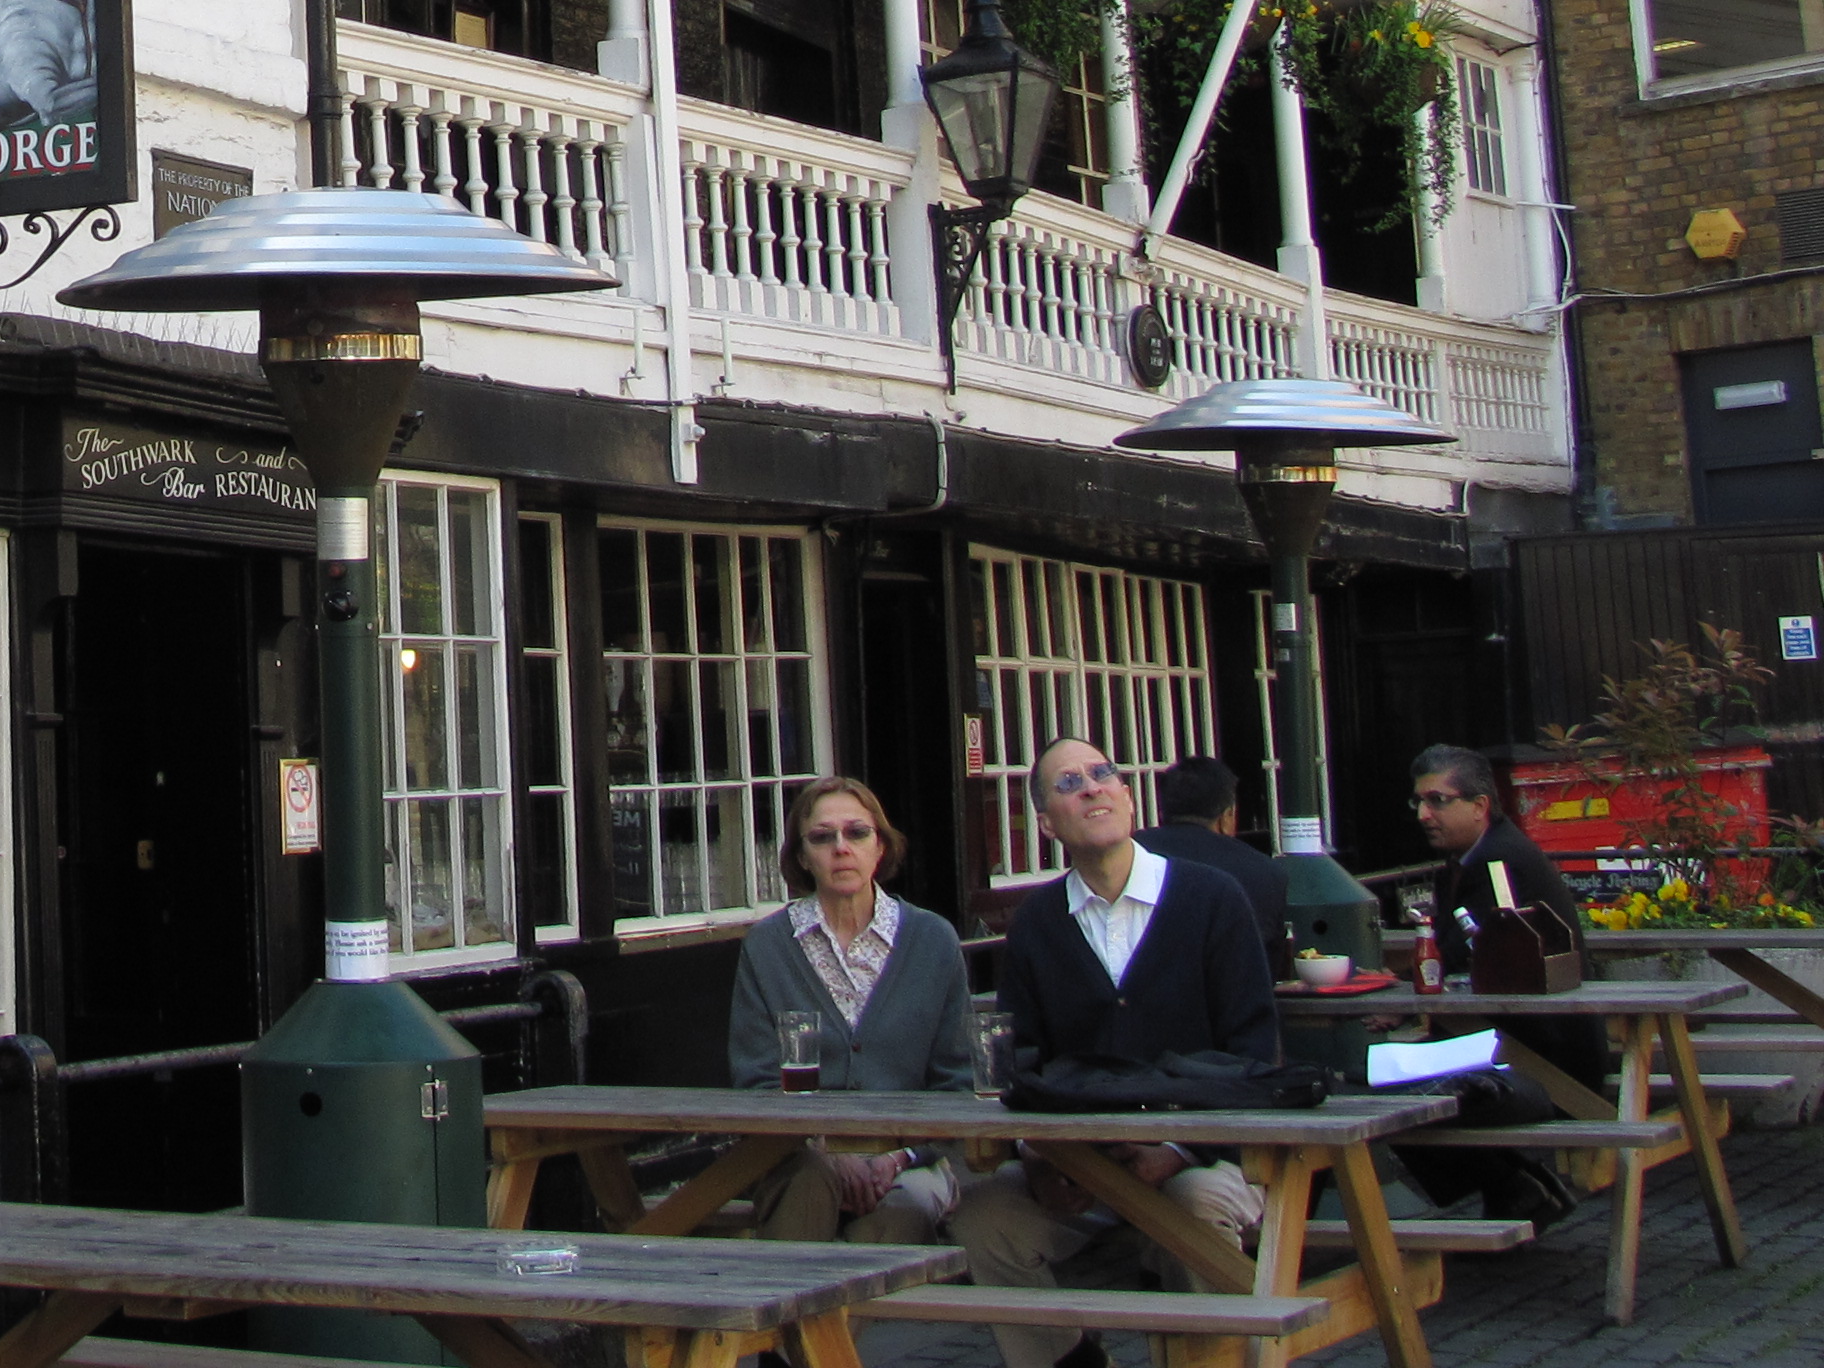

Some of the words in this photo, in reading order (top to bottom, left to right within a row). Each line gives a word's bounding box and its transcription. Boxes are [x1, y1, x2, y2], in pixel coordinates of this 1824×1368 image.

[158, 168, 177, 183] THE
[178, 171, 221, 192] PROPERTY
[221, 182, 233, 195] OF
[234, 184, 250, 197] THE
[167, 190, 218, 218] NATIO
[64, 428, 124, 462] The
[253, 446, 287, 470] and
[81, 439, 197, 489] SOUTHWARK
[143, 466, 205, 499] Bar
[215, 471, 317, 511] RESTAURAN
